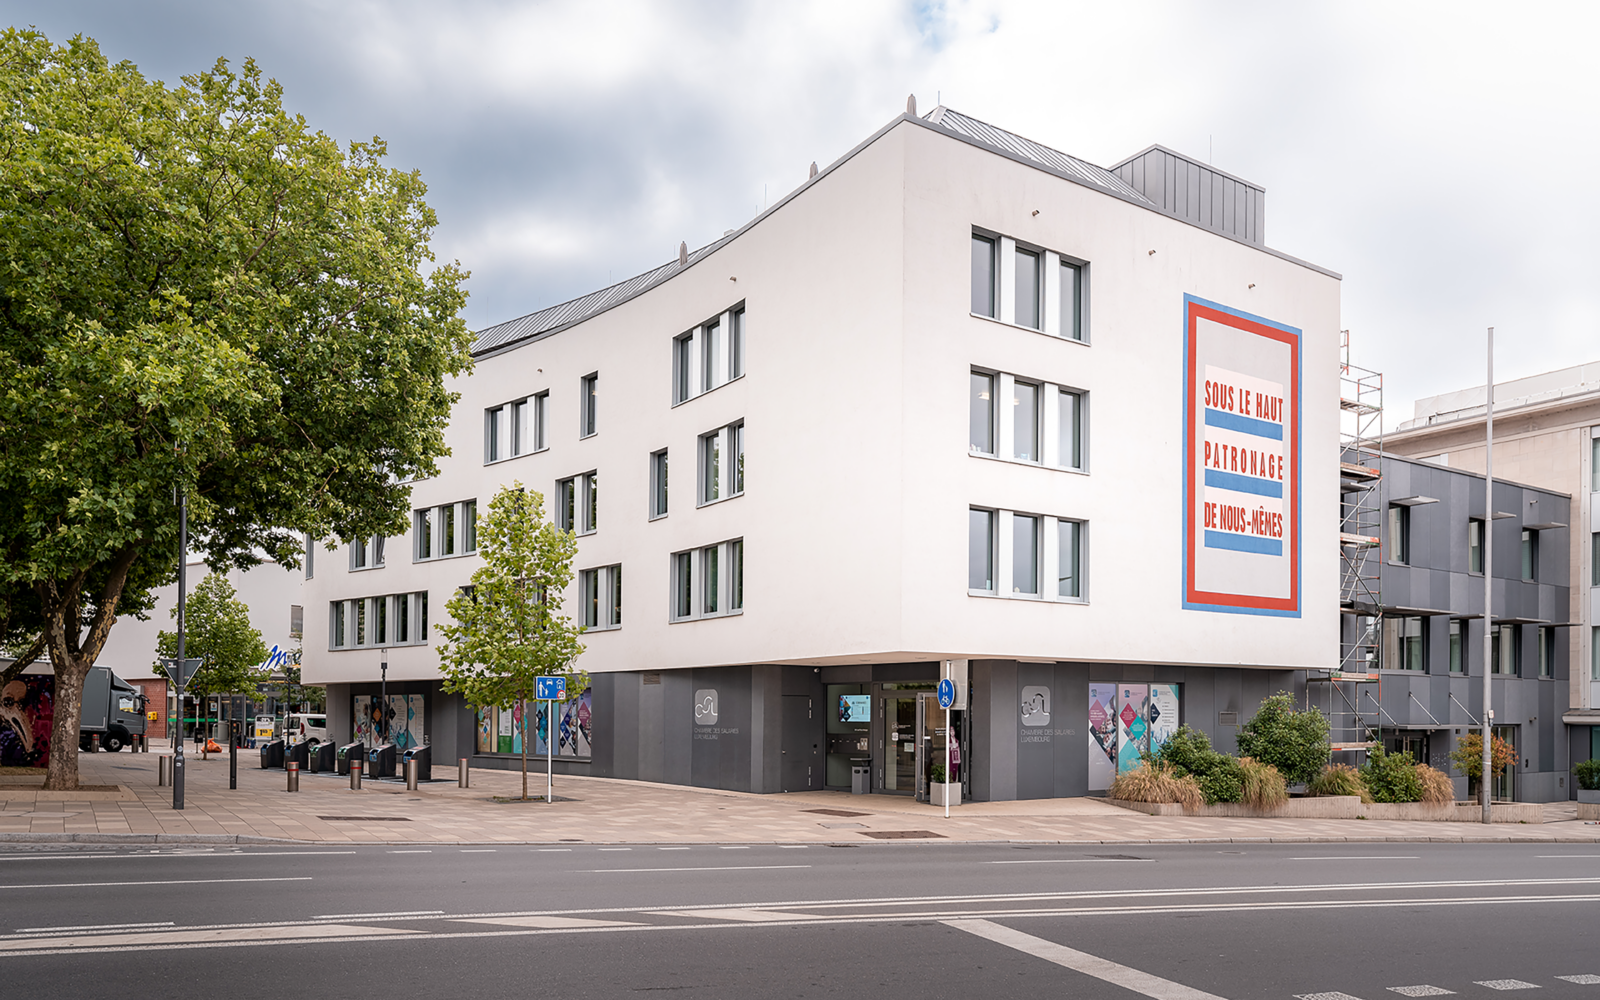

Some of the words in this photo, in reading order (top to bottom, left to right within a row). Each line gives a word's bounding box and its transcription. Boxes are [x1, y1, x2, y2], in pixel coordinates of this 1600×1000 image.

[1205, 380, 1234, 412] SOUS
[1239, 388, 1250, 415] LE
[1256, 392, 1283, 422] HAUT
[1205, 441, 1283, 480] PATRONAGE
[1204, 501, 1216, 529] DE
[1220, 504, 1283, 538] NOUS-MÊMES
